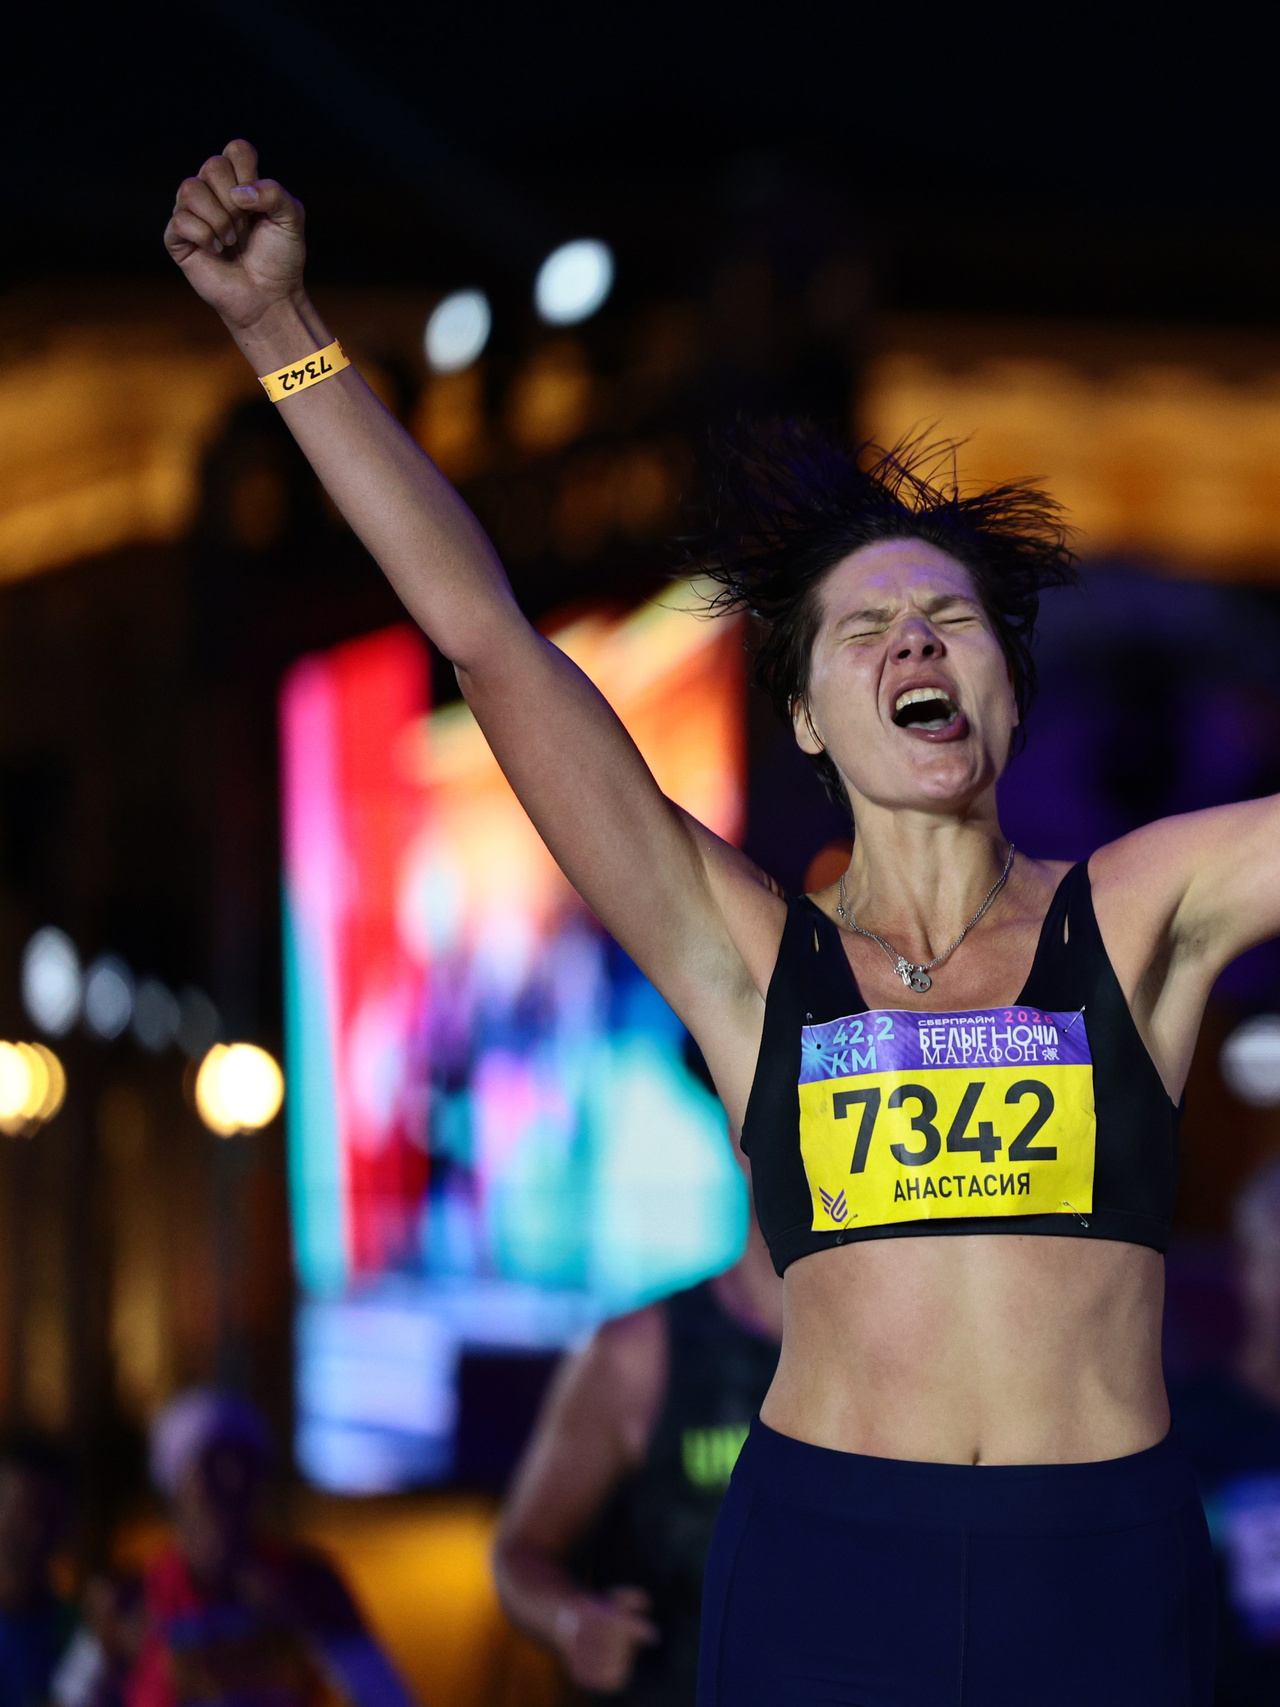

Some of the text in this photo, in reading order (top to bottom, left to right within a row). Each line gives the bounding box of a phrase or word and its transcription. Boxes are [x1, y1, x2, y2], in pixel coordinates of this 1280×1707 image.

[278, 356, 333, 391] 7342
[832, 1016, 895, 1047] 42,2
[918, 1010, 1054, 1027] СБЕРПРАЙМ 2026
[918, 1025, 1059, 1050] БЕЛЫЕ НОЧИ
[831, 1046, 878, 1076] КМ
[921, 1043, 1039, 1066] МАРАФОН
[832, 1079, 1058, 1175] 7342
[893, 1172, 1031, 1203] АНАСТАСИЯ
